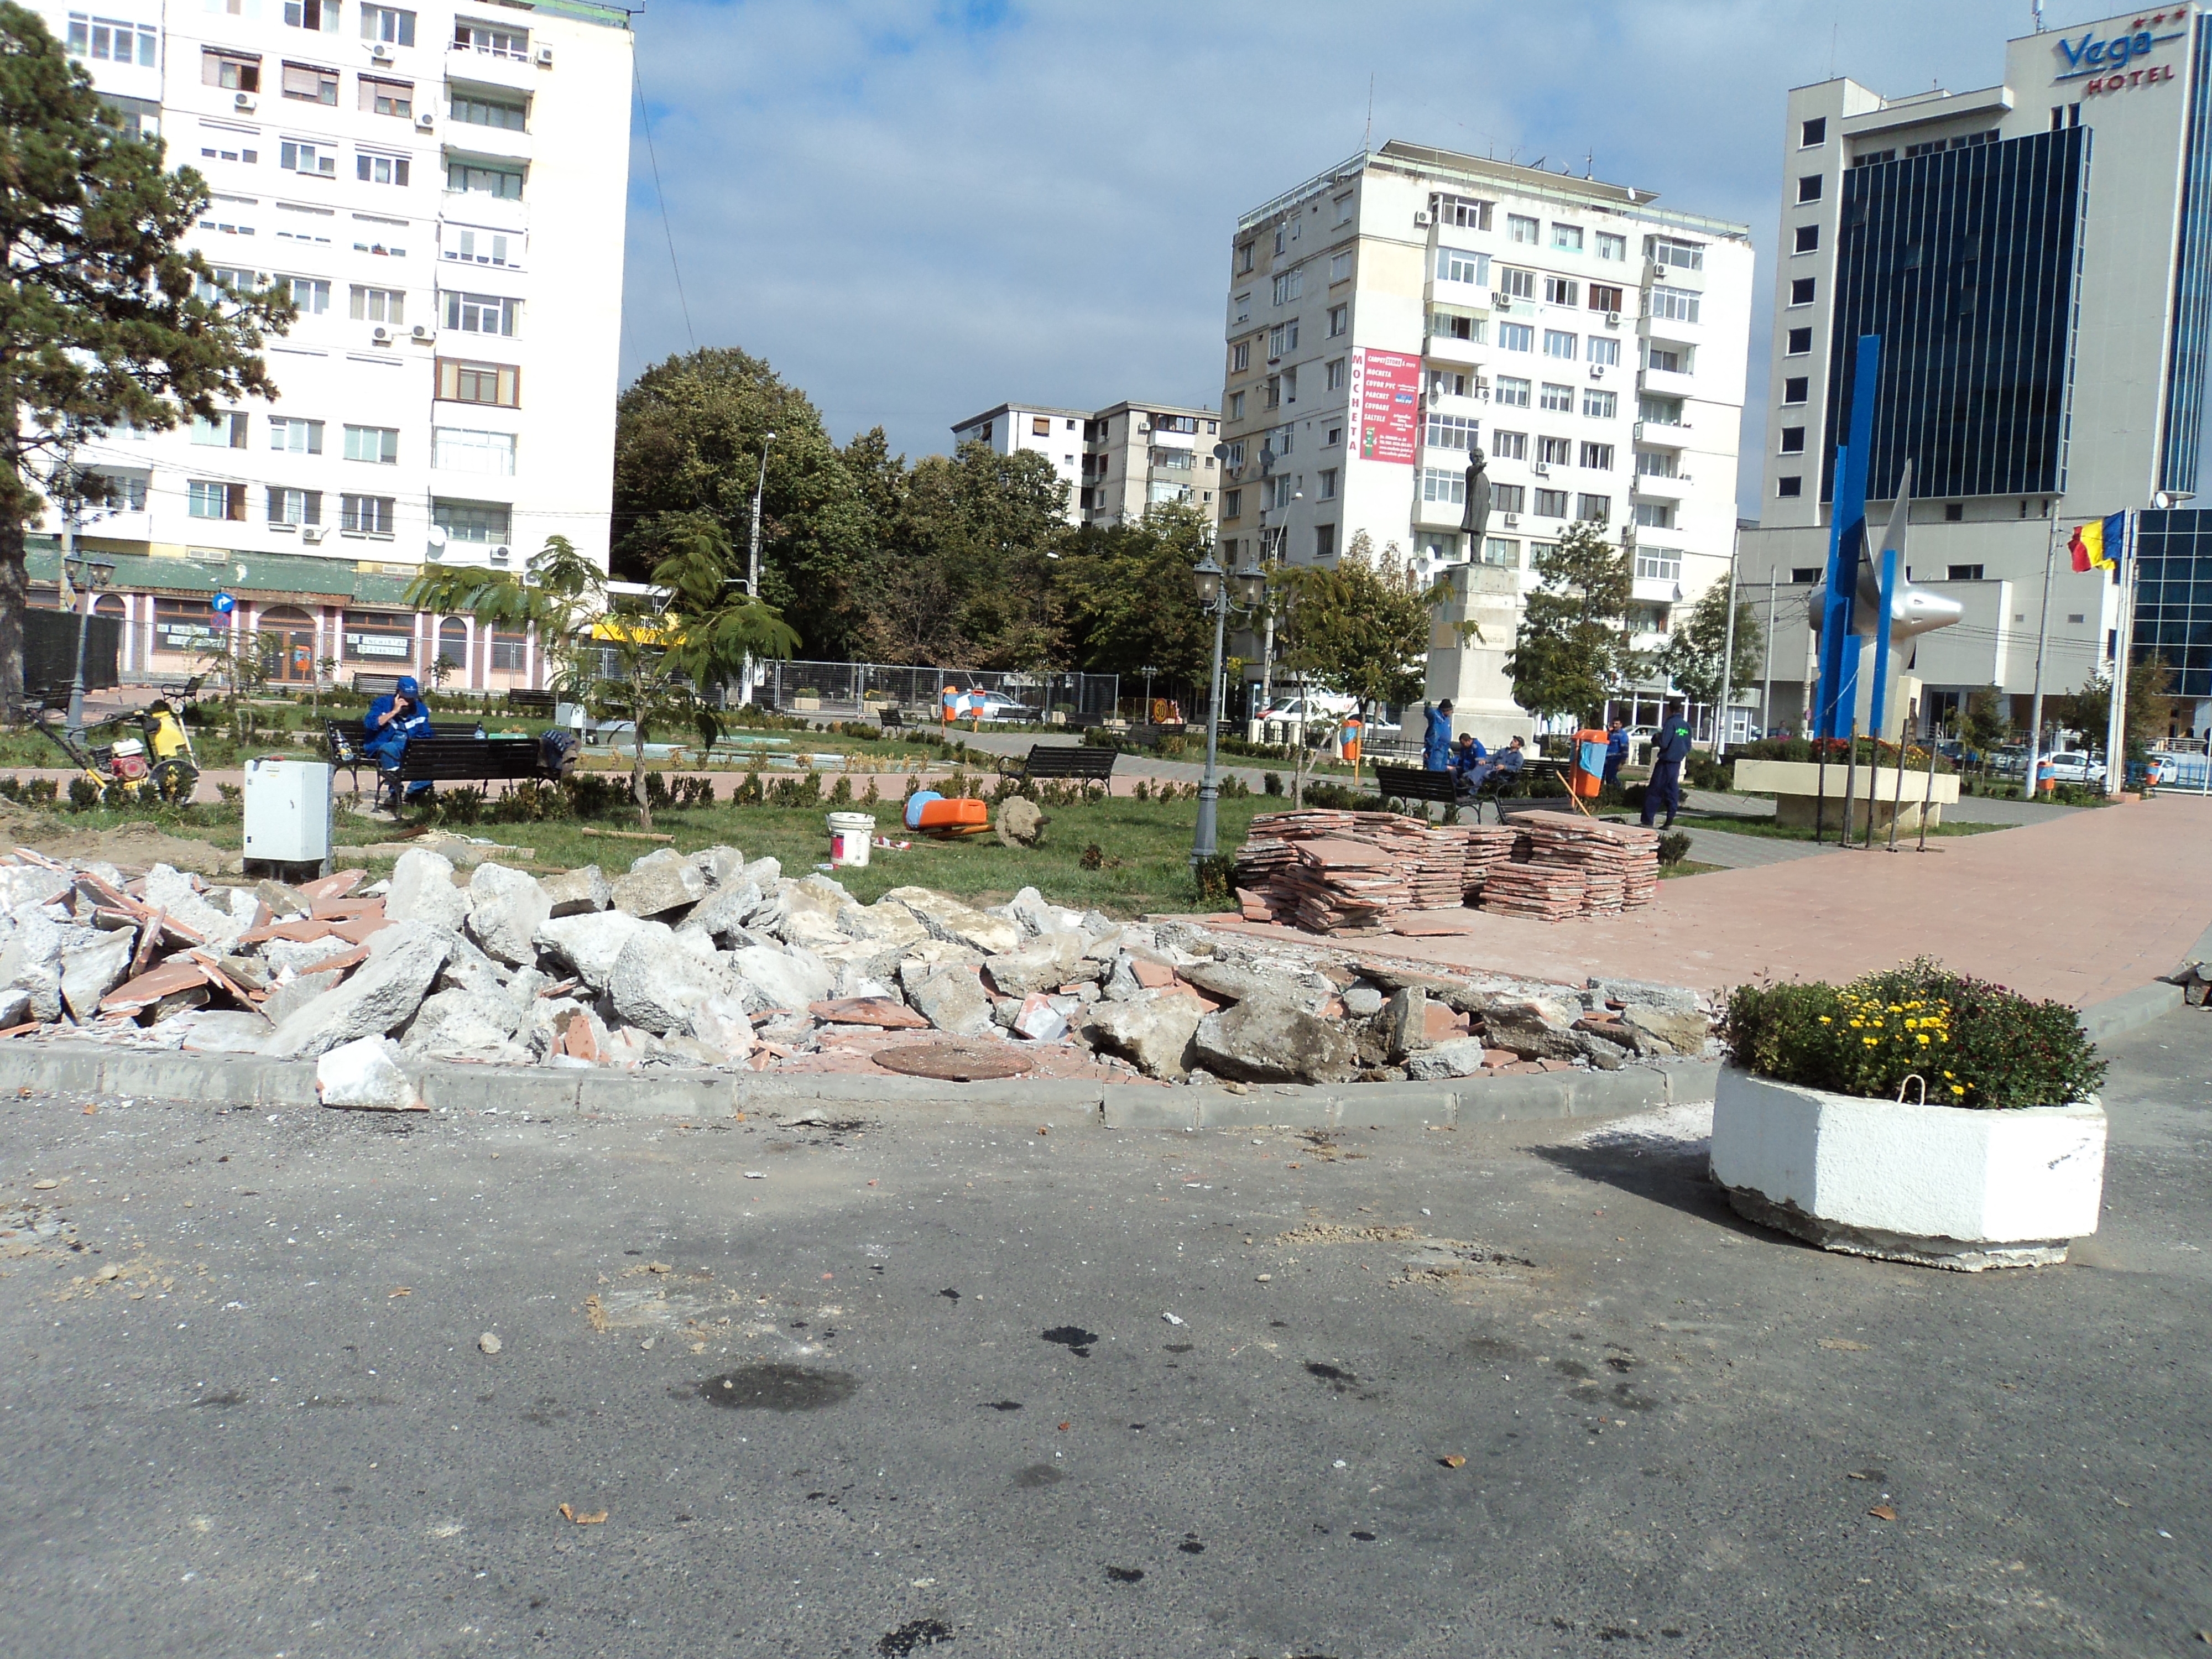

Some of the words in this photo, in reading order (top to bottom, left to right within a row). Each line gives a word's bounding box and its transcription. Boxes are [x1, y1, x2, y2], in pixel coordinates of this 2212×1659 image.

[2058, 31, 2151, 70] Vega
[2087, 65, 2174, 95] HOTEL
[1366, 368, 1391, 377] MOCHETA
[1365, 379, 1384, 388] COVOR
[1365, 390, 1389, 400] PARCHET
[1349, 354, 1363, 451] MOCHETA
[1364, 402, 1389, 411] COVOARE
[1364, 413, 1386, 422] SALTELE
[1156, 704, 1165, 717] 30
